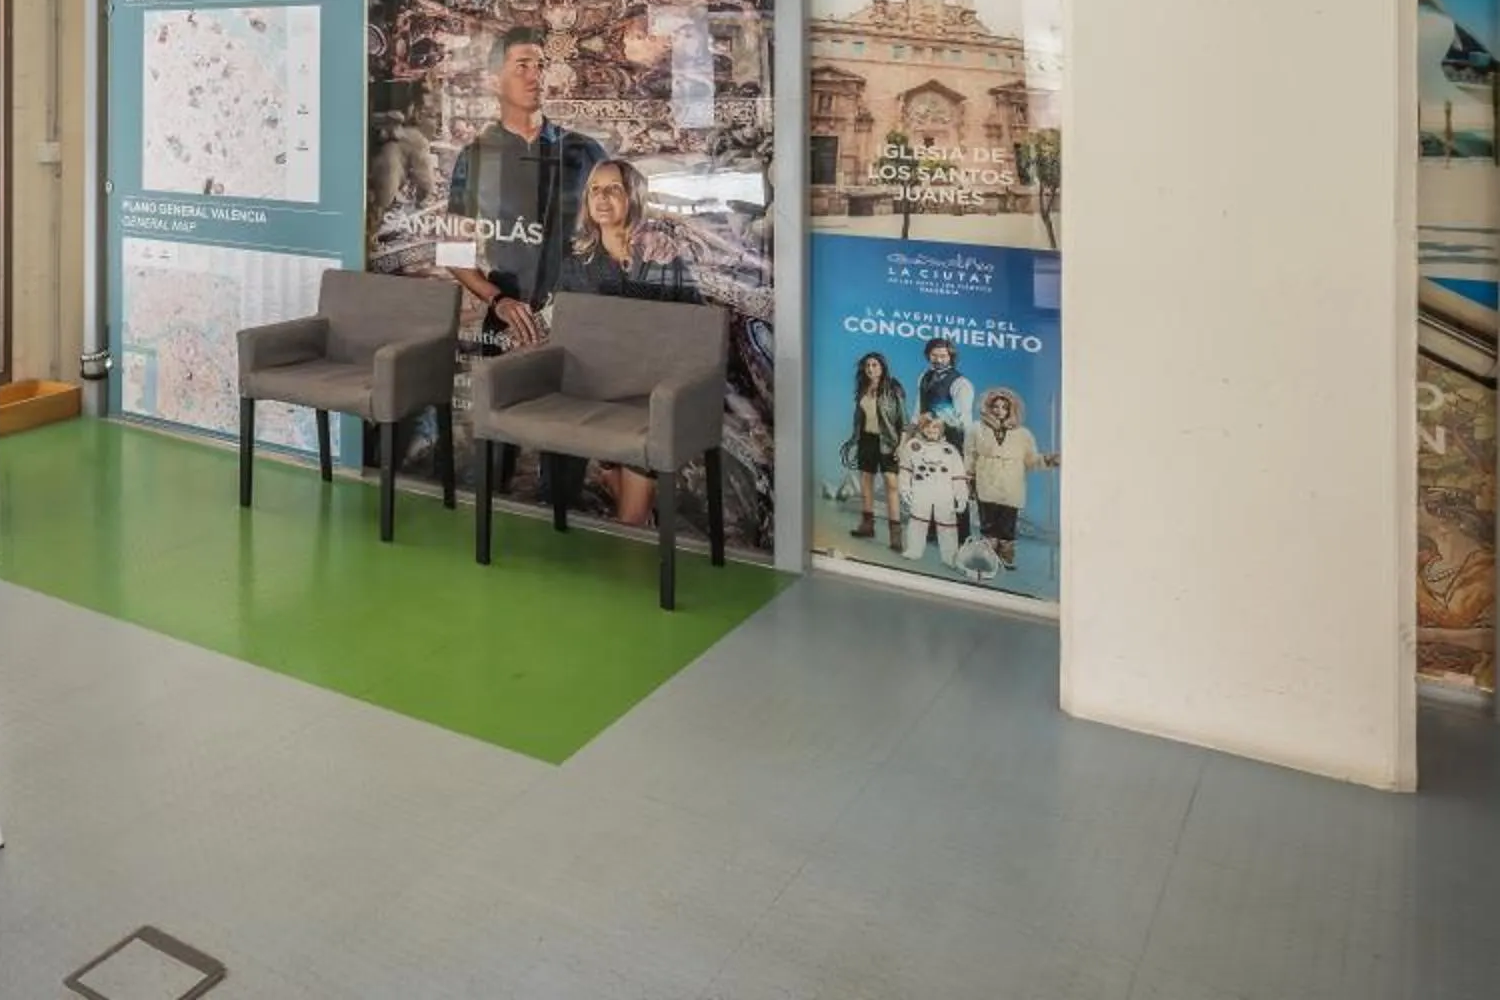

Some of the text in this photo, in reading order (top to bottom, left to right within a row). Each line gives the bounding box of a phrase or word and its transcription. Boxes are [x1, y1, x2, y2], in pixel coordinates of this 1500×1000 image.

[973, 147, 1008, 164] DE
[868, 164, 1015, 186] LOS SANTOS
[893, 185, 985, 207] JUANES
[123, 200, 267, 223] PLANO GENERAL VALENCIA
[124, 216, 197, 232] GENERAL MAP
[383, 211, 544, 245] SAN NICOLÁS
[887, 267, 993, 285] LA CIUTAT
[867, 307, 1017, 332] LA AVENTURA DEL
[843, 316, 1043, 353] CONOCIMIENTO
